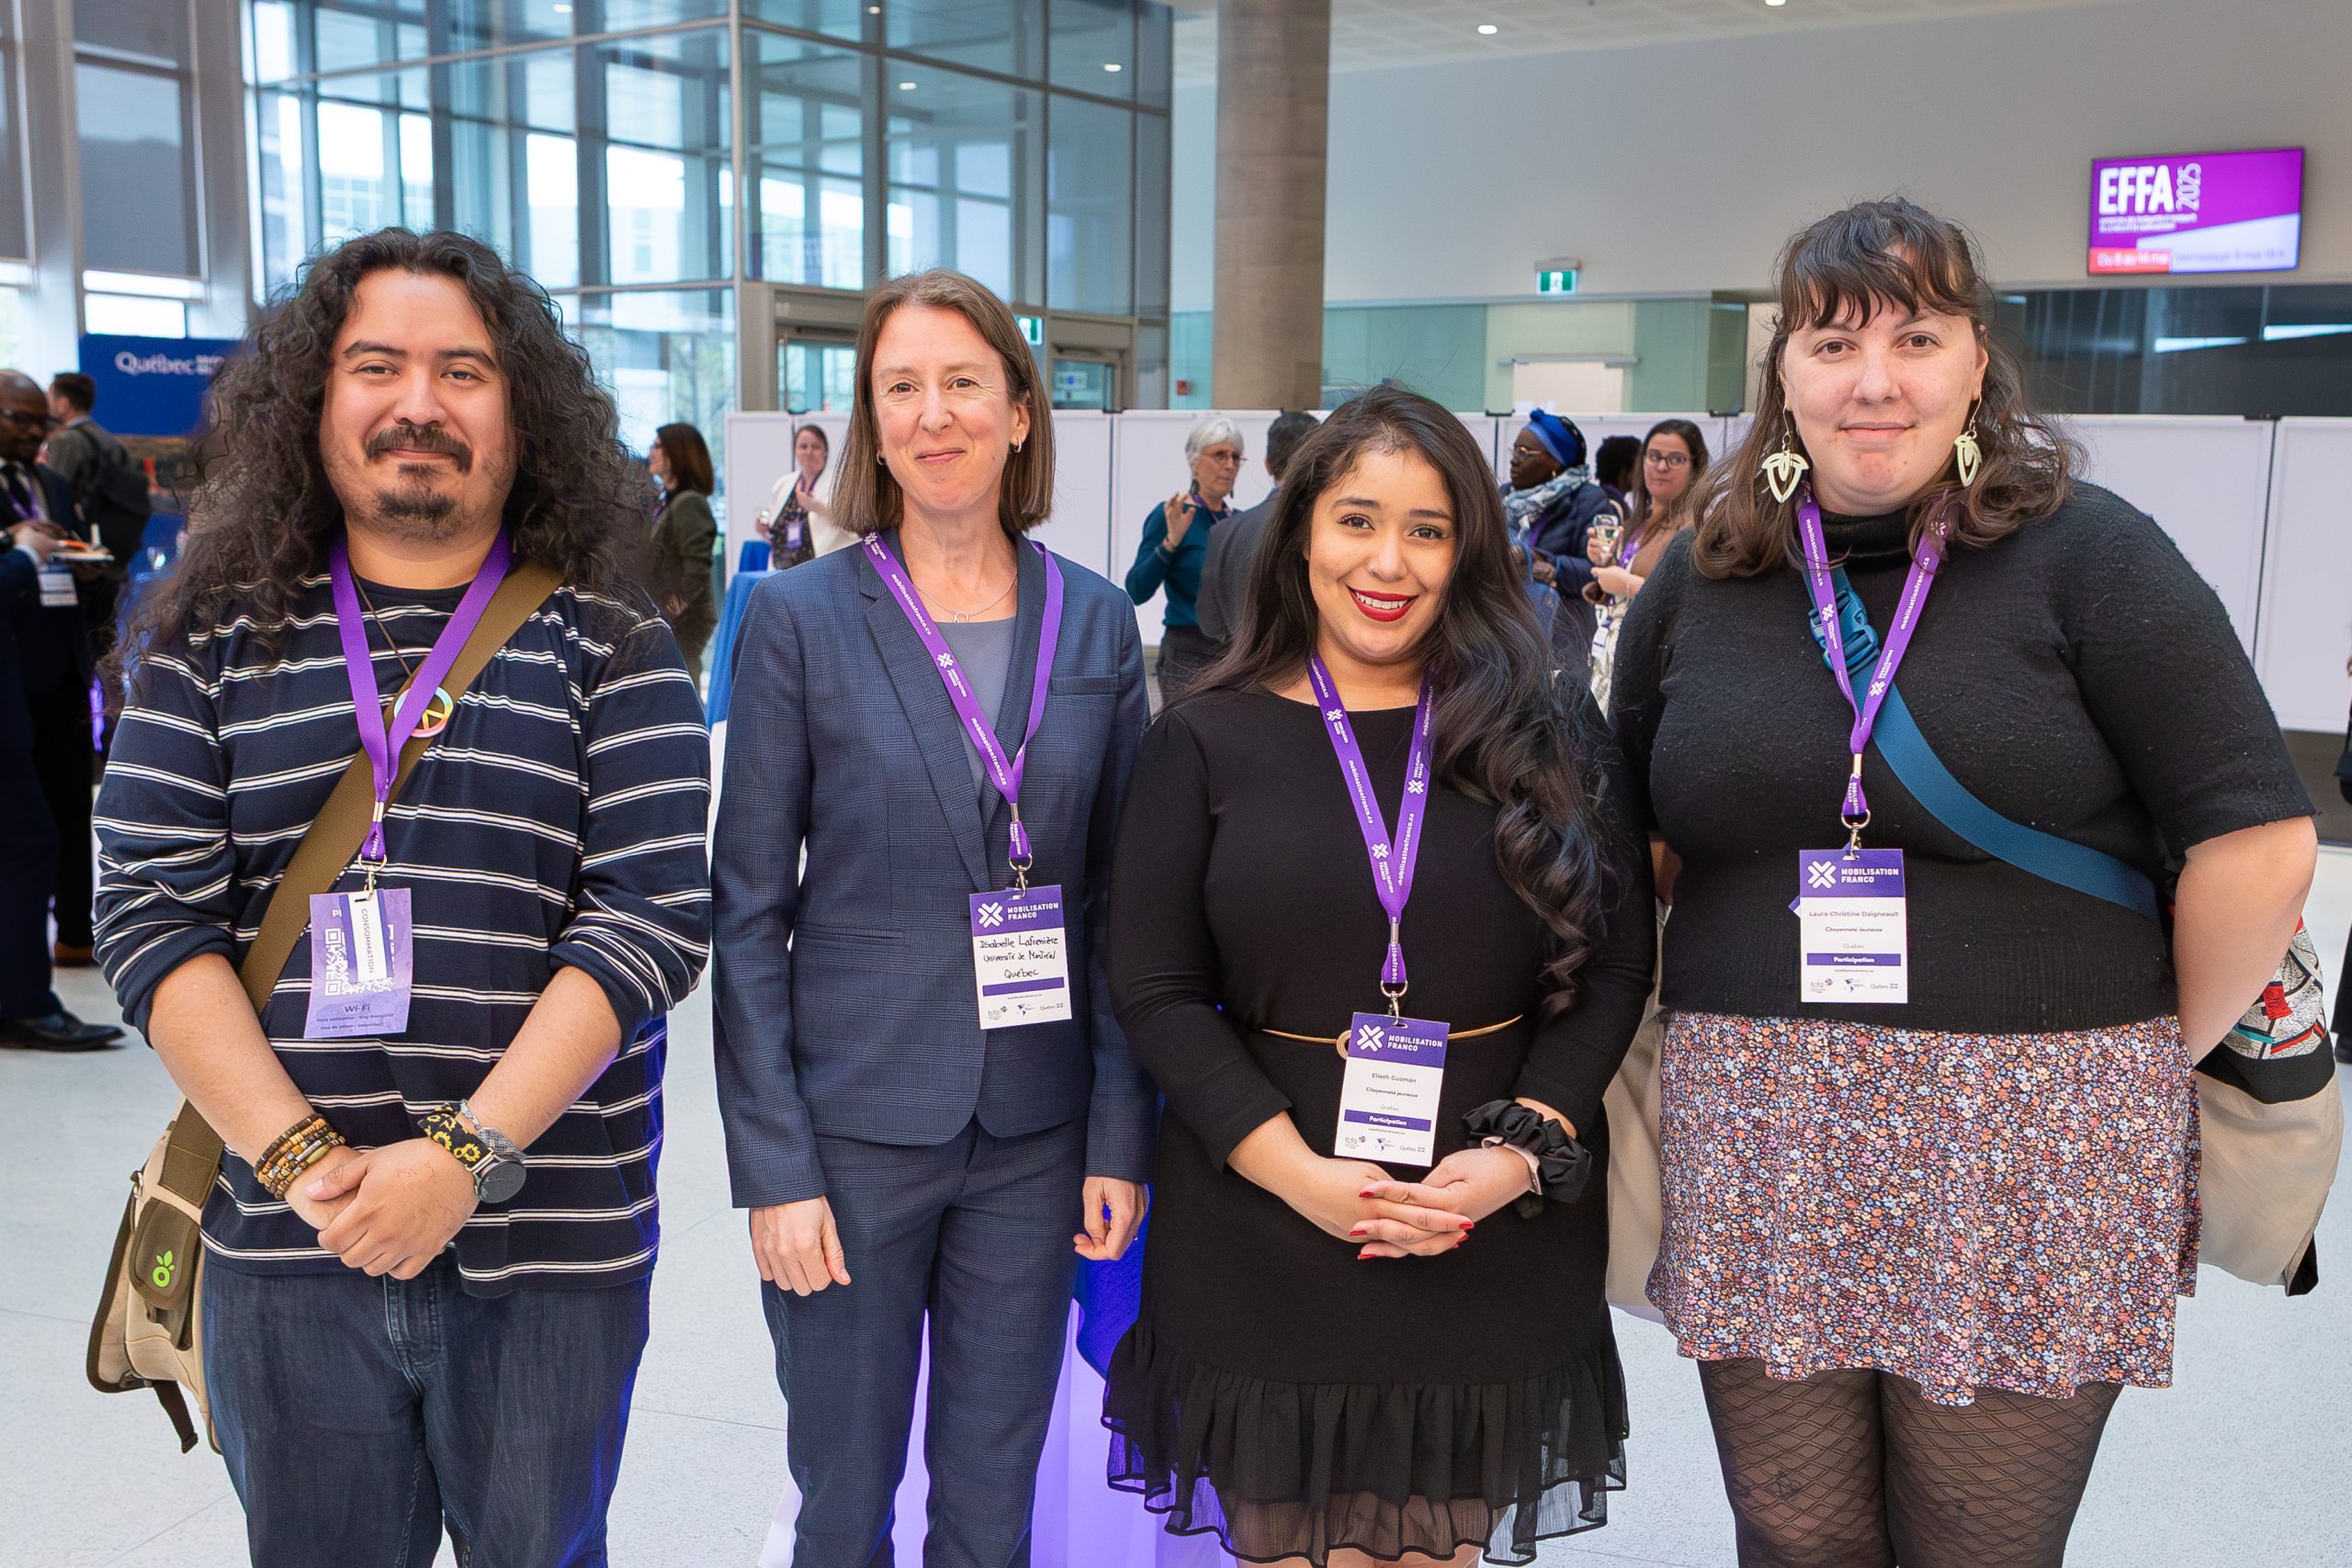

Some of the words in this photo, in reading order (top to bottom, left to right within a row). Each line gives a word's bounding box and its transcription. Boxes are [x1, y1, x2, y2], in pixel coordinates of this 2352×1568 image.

[2098, 164, 2175, 215] EFFA
[2176, 163, 2202, 212] 2025
[115, 351, 195, 376] Québec
[891, 573, 932, 636] mobilisationfranco.ca
[971, 717, 1007, 785] mobilisationfranco.ca
[1349, 760, 1374, 824] mobilisationfranco.ca
[1007, 902, 1058, 914] MOBILISATION
[1008, 912, 1037, 920] FRANCO
[361, 908, 375, 974] CONSOMMATION
[979, 938, 1015, 948] Isabelle
[1833, 956, 1875, 964] Participation
[1004, 967, 1039, 979] Québec
[345, 1003, 370, 1012] Wi-Fi
[1387, 1042, 1419, 1052] FRANCO
[1388, 1034, 1442, 1048] MOBILISATION
[1369, 1115, 1408, 1126] Participation
